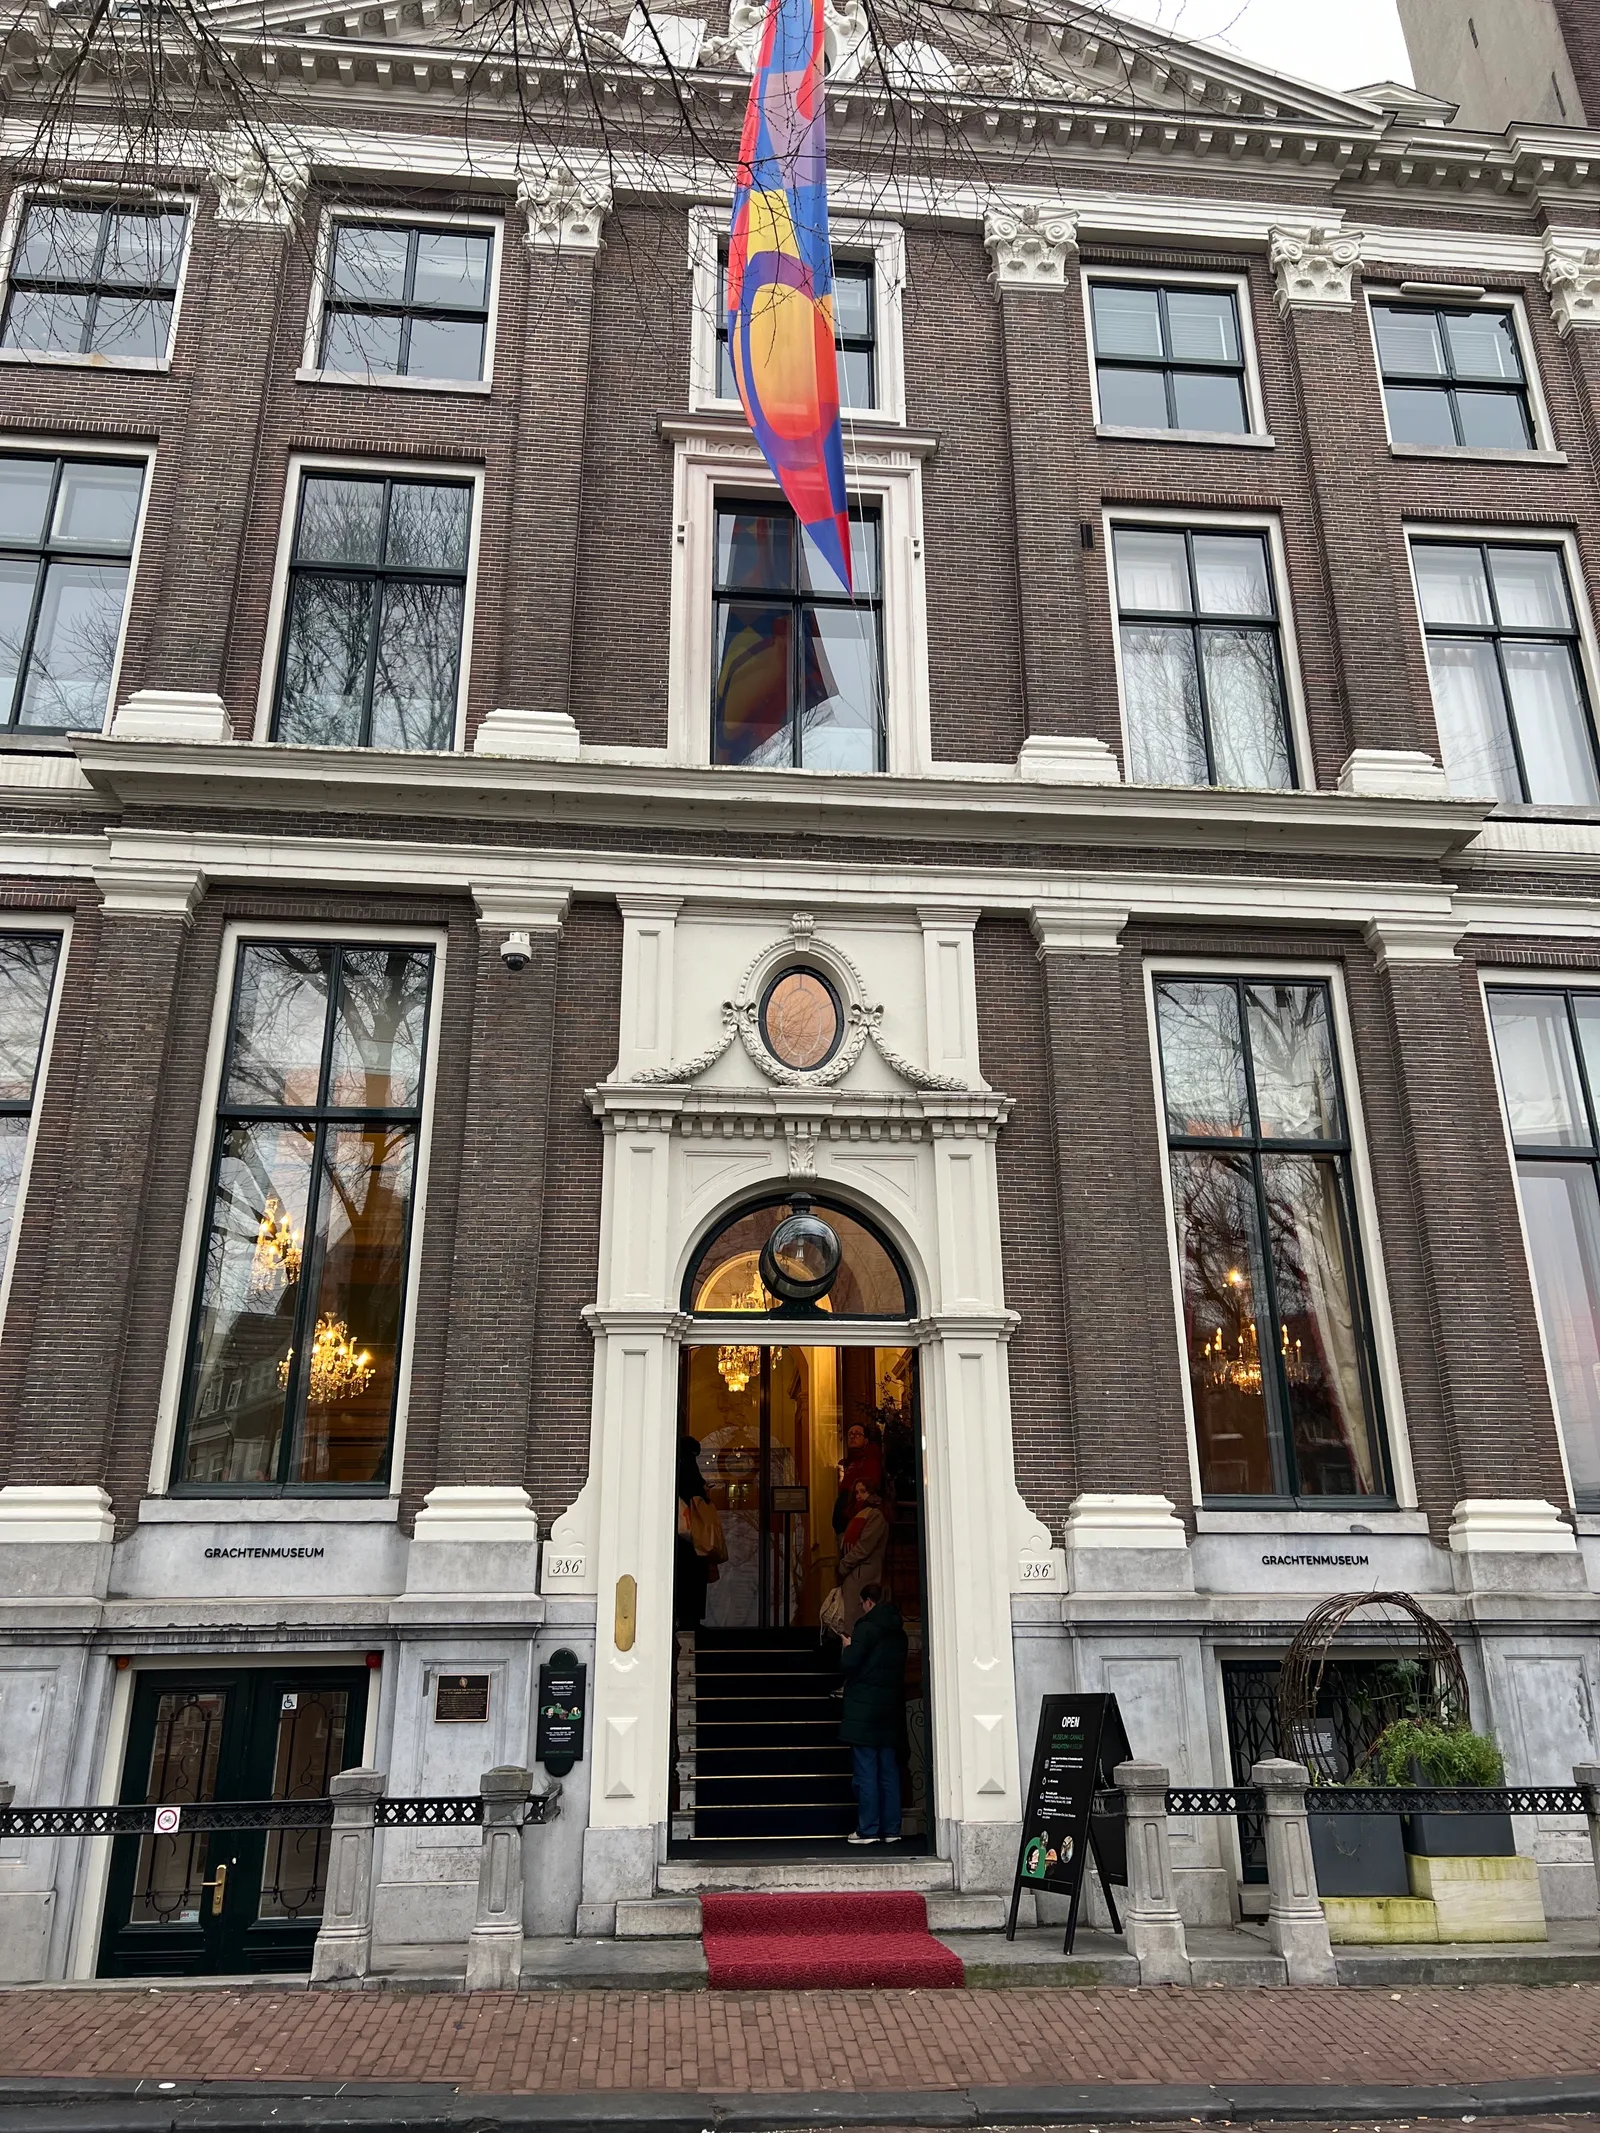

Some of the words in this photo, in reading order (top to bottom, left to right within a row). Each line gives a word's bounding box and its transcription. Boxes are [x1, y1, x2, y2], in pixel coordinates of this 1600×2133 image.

[204, 1548, 324, 1558] GRACHTENMUSEUM
[1261, 1555, 1369, 1565] GRACHTENMUSEUM
[553, 1559, 582, 1574] 386
[1023, 1563, 1051, 1578] 386
[1061, 1716, 1080, 1728] OPEN
